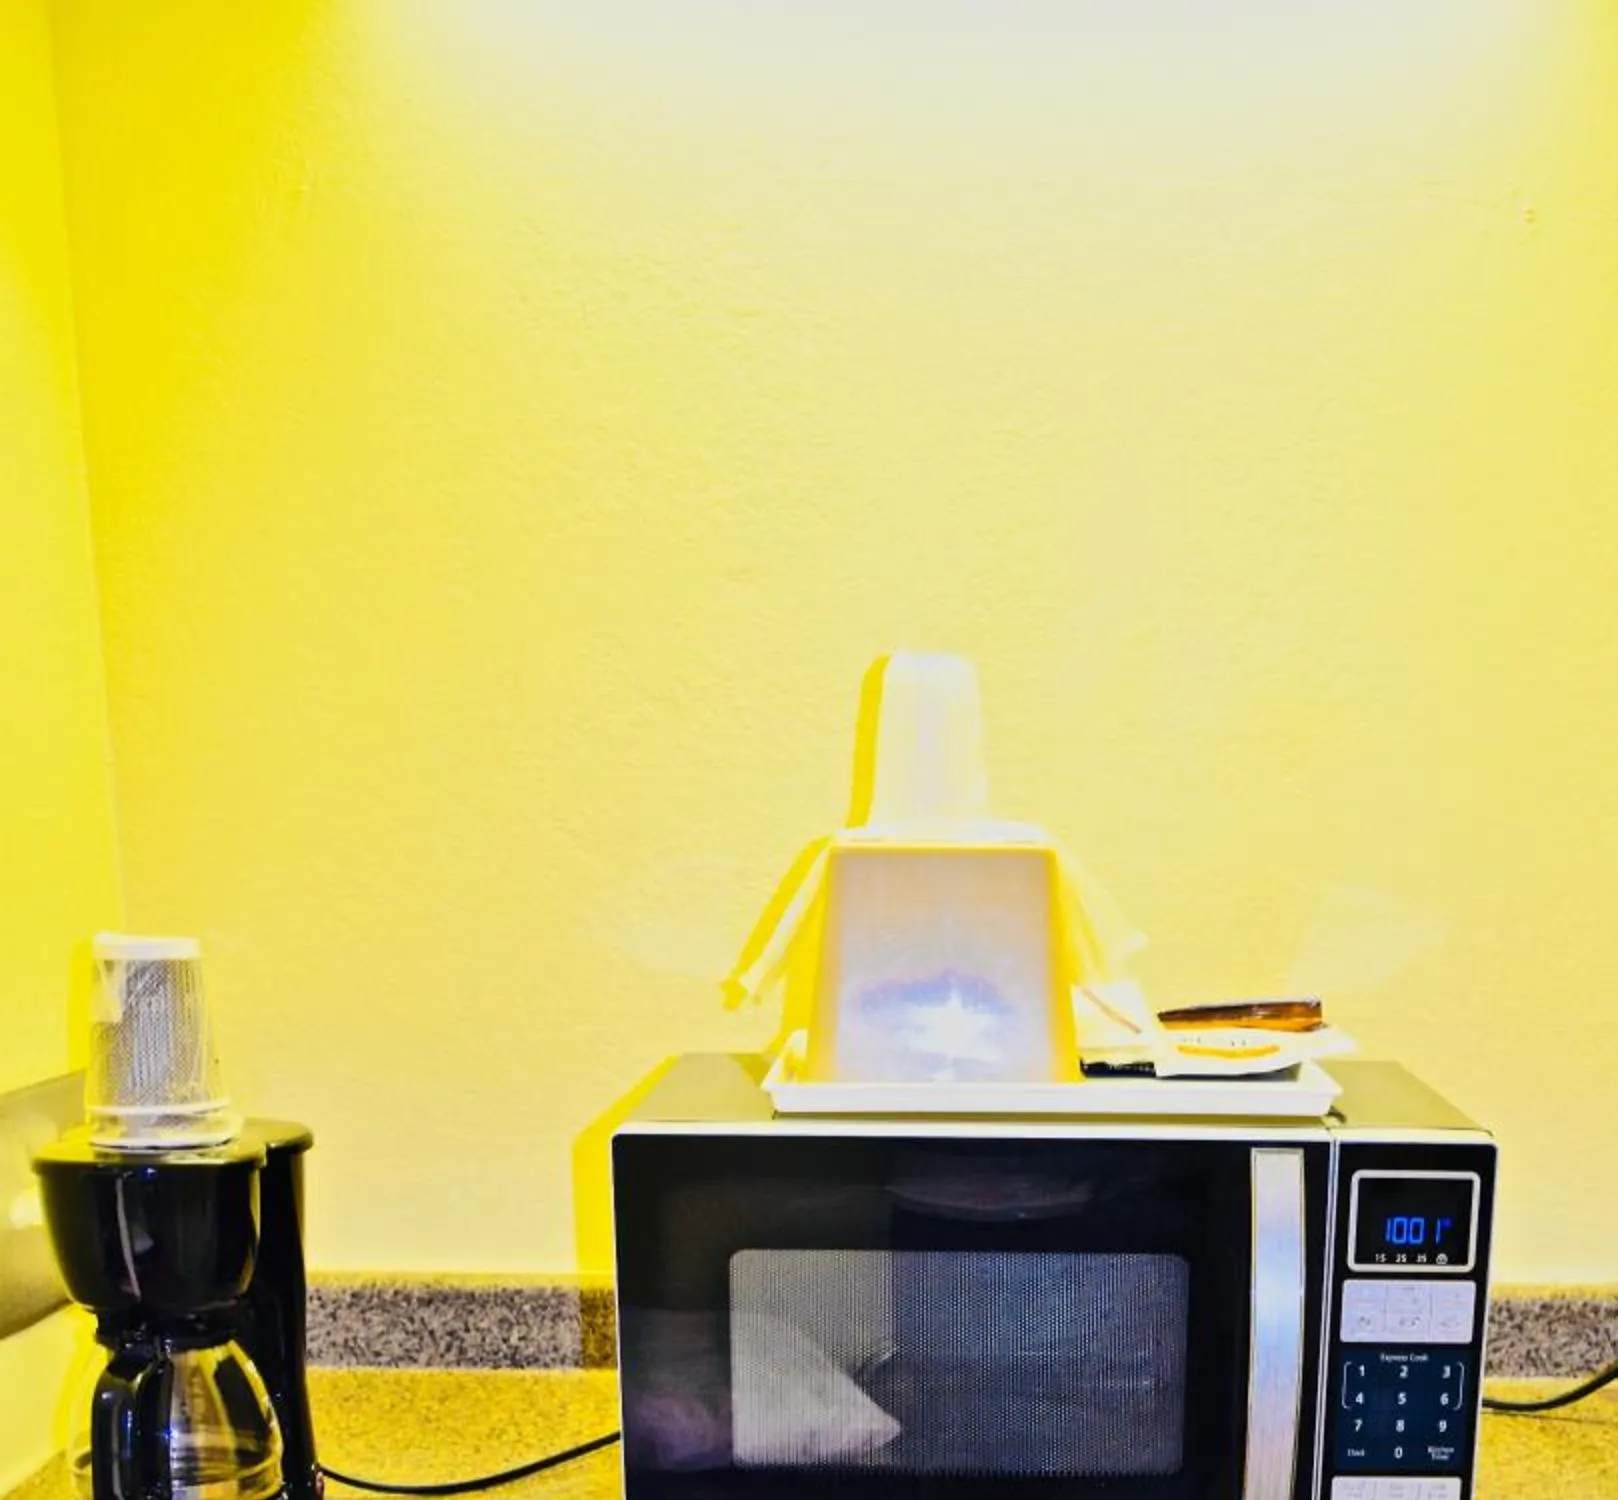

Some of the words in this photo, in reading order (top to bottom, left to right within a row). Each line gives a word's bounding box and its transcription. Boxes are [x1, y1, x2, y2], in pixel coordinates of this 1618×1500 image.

[1359, 1365, 1365, 1377] 1
[1400, 1365, 1408, 1378] 2
[1442, 1366, 1450, 1378] 3
[1355, 1392, 1364, 1404] 4
[1398, 1392, 1407, 1405] 5
[1440, 1393, 1448, 1405] 6
[1354, 1419, 1363, 1432] 7
[1396, 1419, 1405, 1432] 8
[1439, 1420, 1447, 1433] 9
[1394, 1446, 1403, 1459] 0
